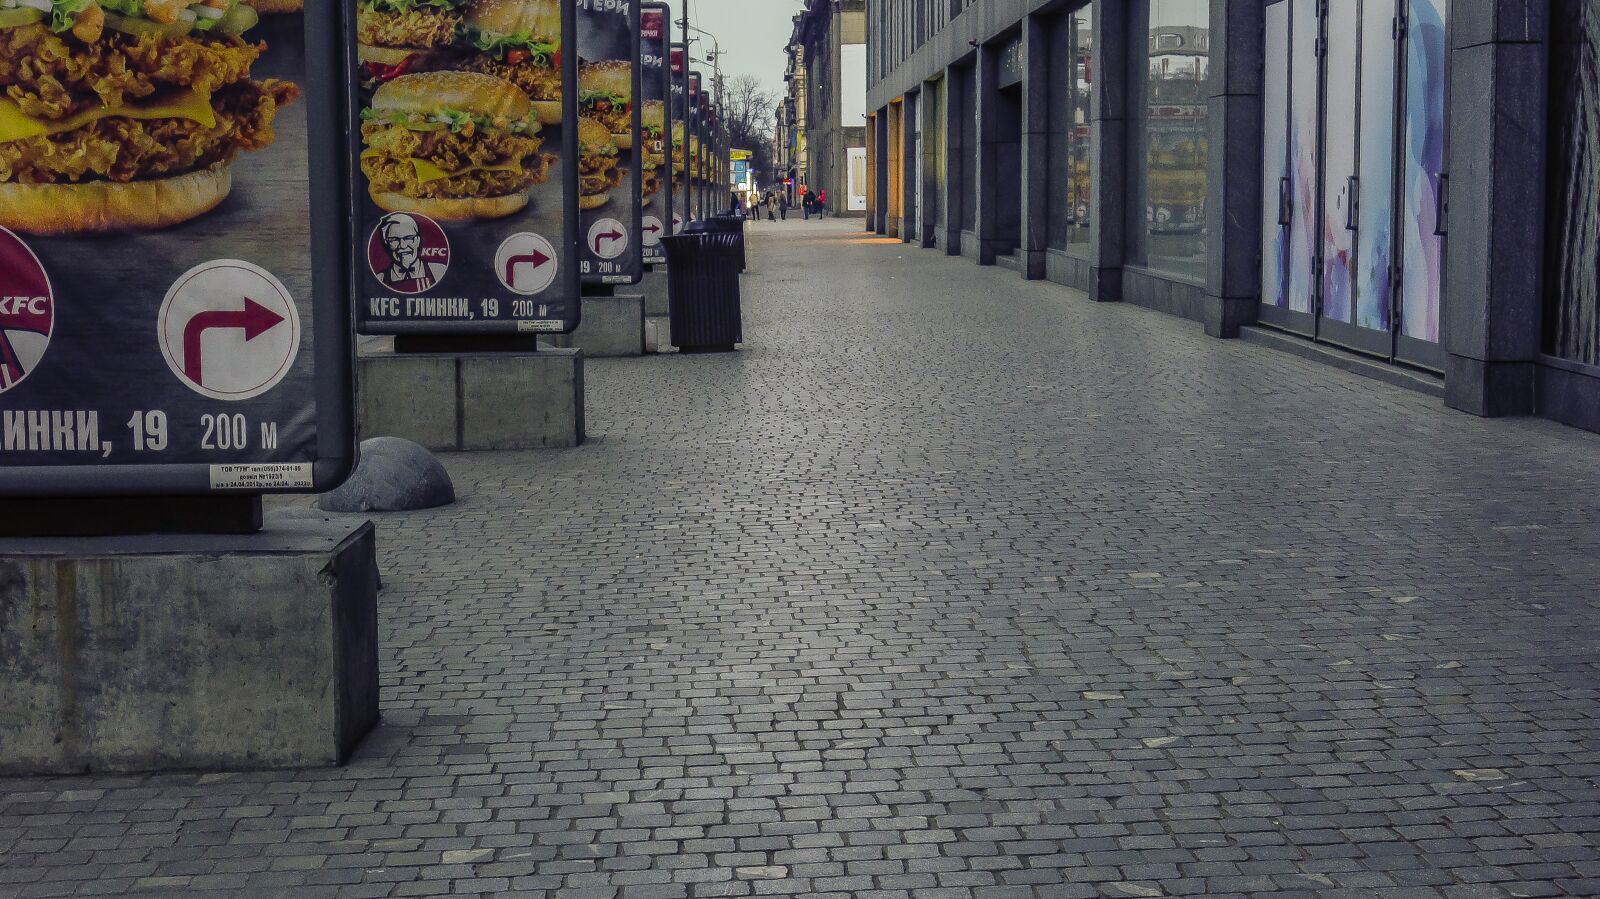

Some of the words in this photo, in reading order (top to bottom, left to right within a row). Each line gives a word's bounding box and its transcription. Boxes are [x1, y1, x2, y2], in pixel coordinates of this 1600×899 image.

[421, 247, 447, 257] KFC
[641, 247, 653, 257] 200
[580, 260, 591, 273] 19
[598, 261, 613, 273] 200
[370, 297, 400, 317] KFC
[406, 297, 475, 320] ГЛИНКИ,
[480, 298, 499, 317] 19
[512, 300, 534, 317] 200
[0, 410, 112, 458] ИНКИ,
[126, 409, 168, 451] 19
[201, 412, 247, 450] 200
